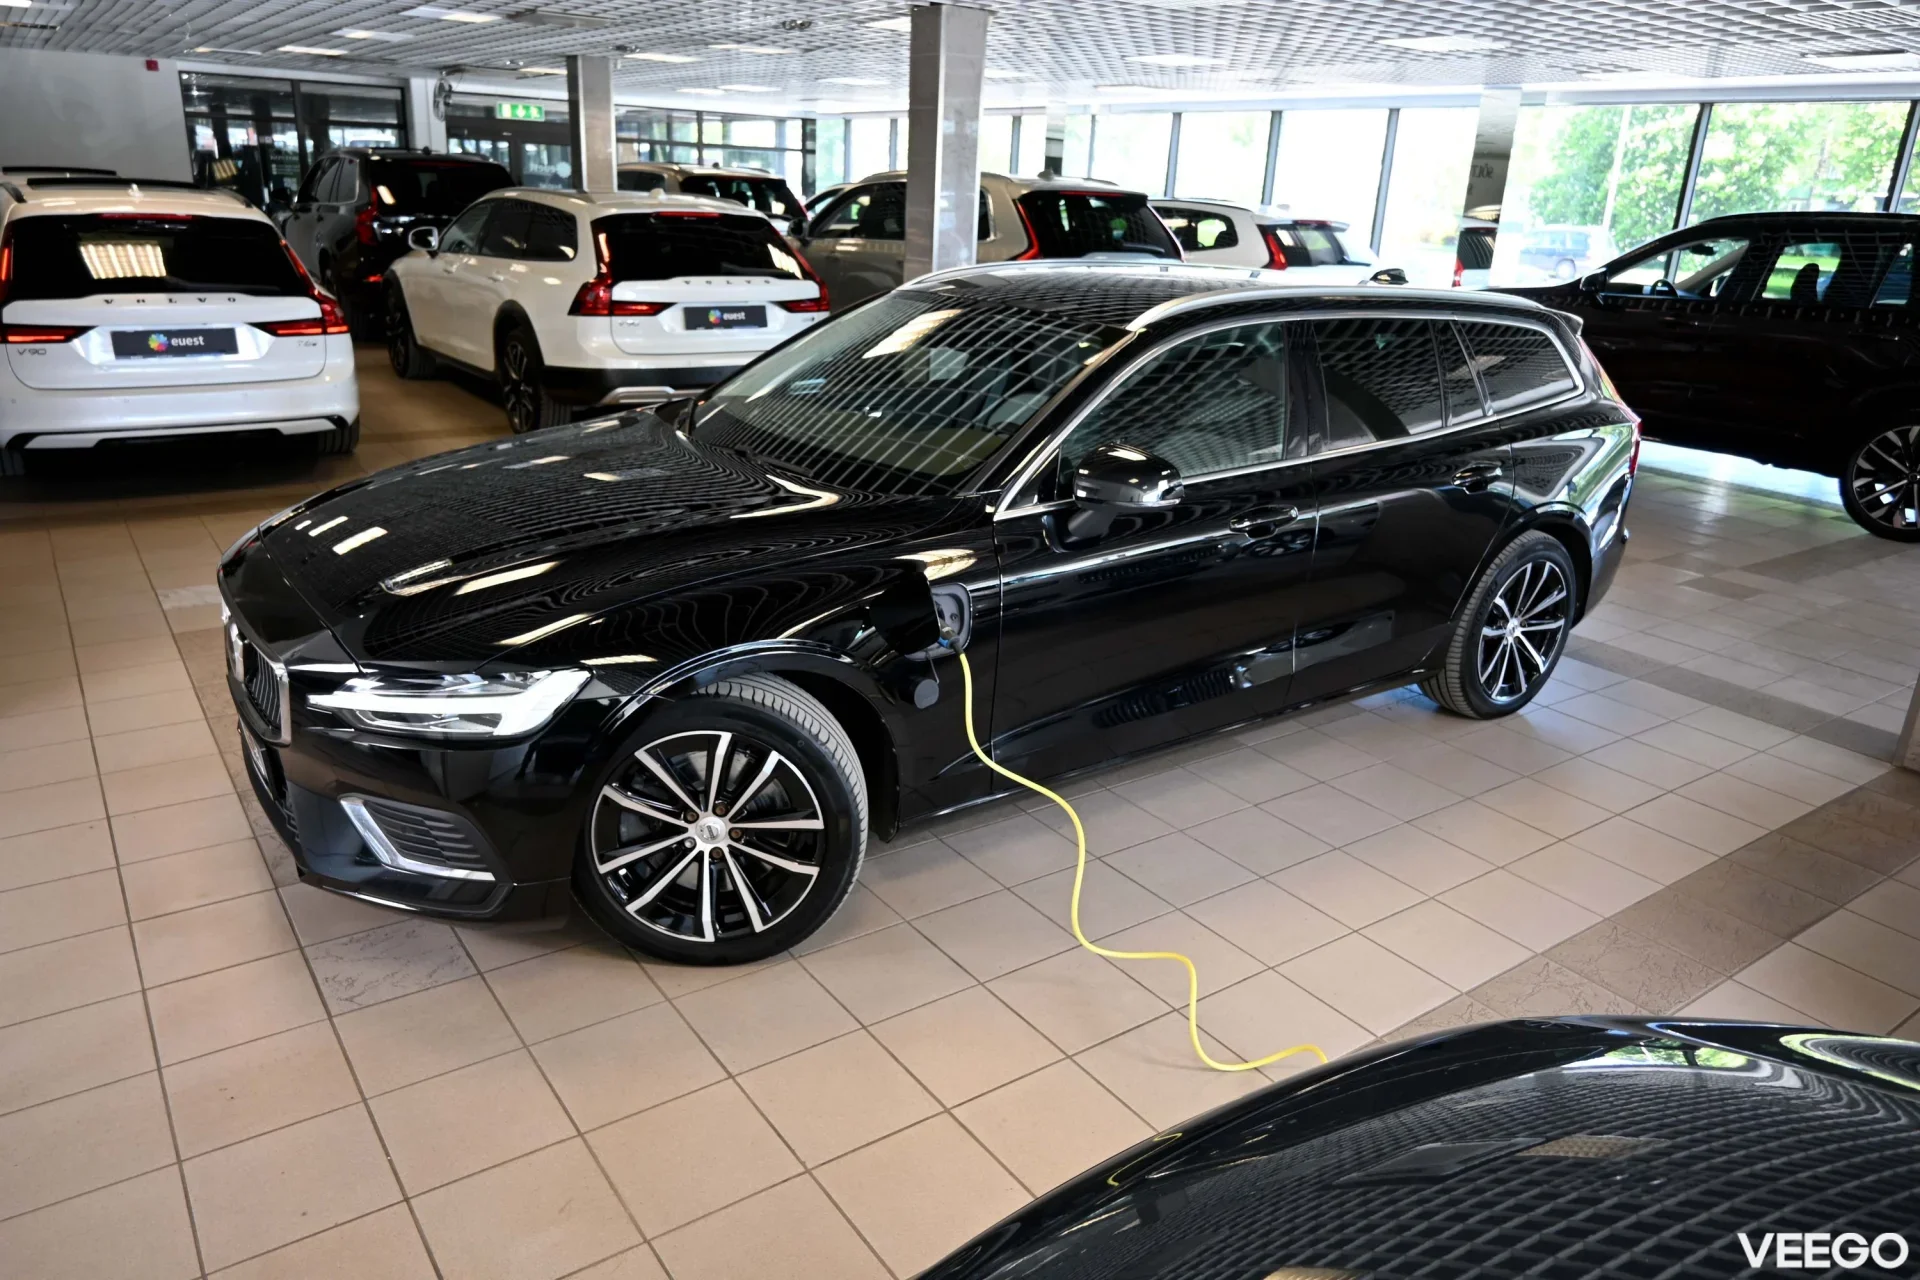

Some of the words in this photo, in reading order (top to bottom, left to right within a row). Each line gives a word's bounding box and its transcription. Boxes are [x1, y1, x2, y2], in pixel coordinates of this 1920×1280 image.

[723, 311, 746, 320] euest
[171, 336, 204, 346] euest
[17, 348, 47, 356] V90
